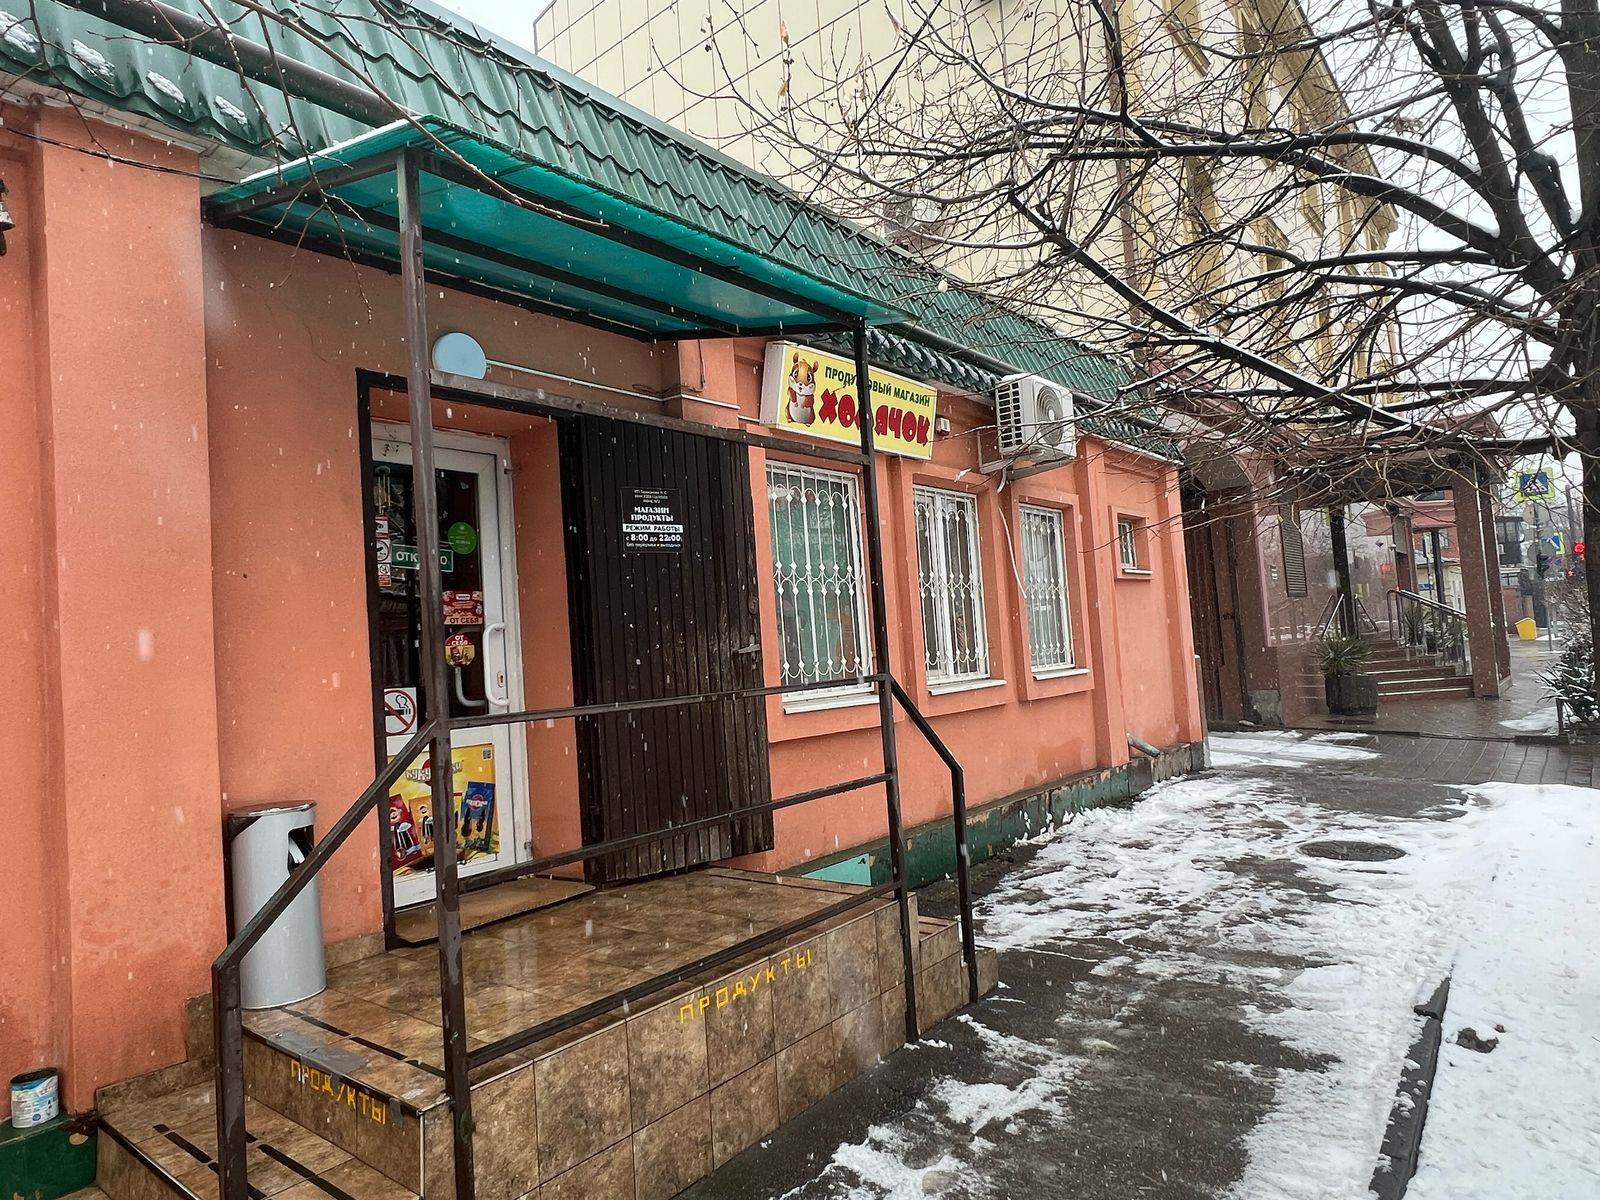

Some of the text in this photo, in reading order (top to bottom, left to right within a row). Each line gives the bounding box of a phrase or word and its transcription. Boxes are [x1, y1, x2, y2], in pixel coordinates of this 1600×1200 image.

[824, 366, 931, 407] ПРОДУОВЫЙ МАГАЗИН
[818, 388, 931, 446] ХОЯЧОК
[395, 551, 448, 566] ОТКО
[679, 948, 812, 1024] ПРОДУКТЫ
